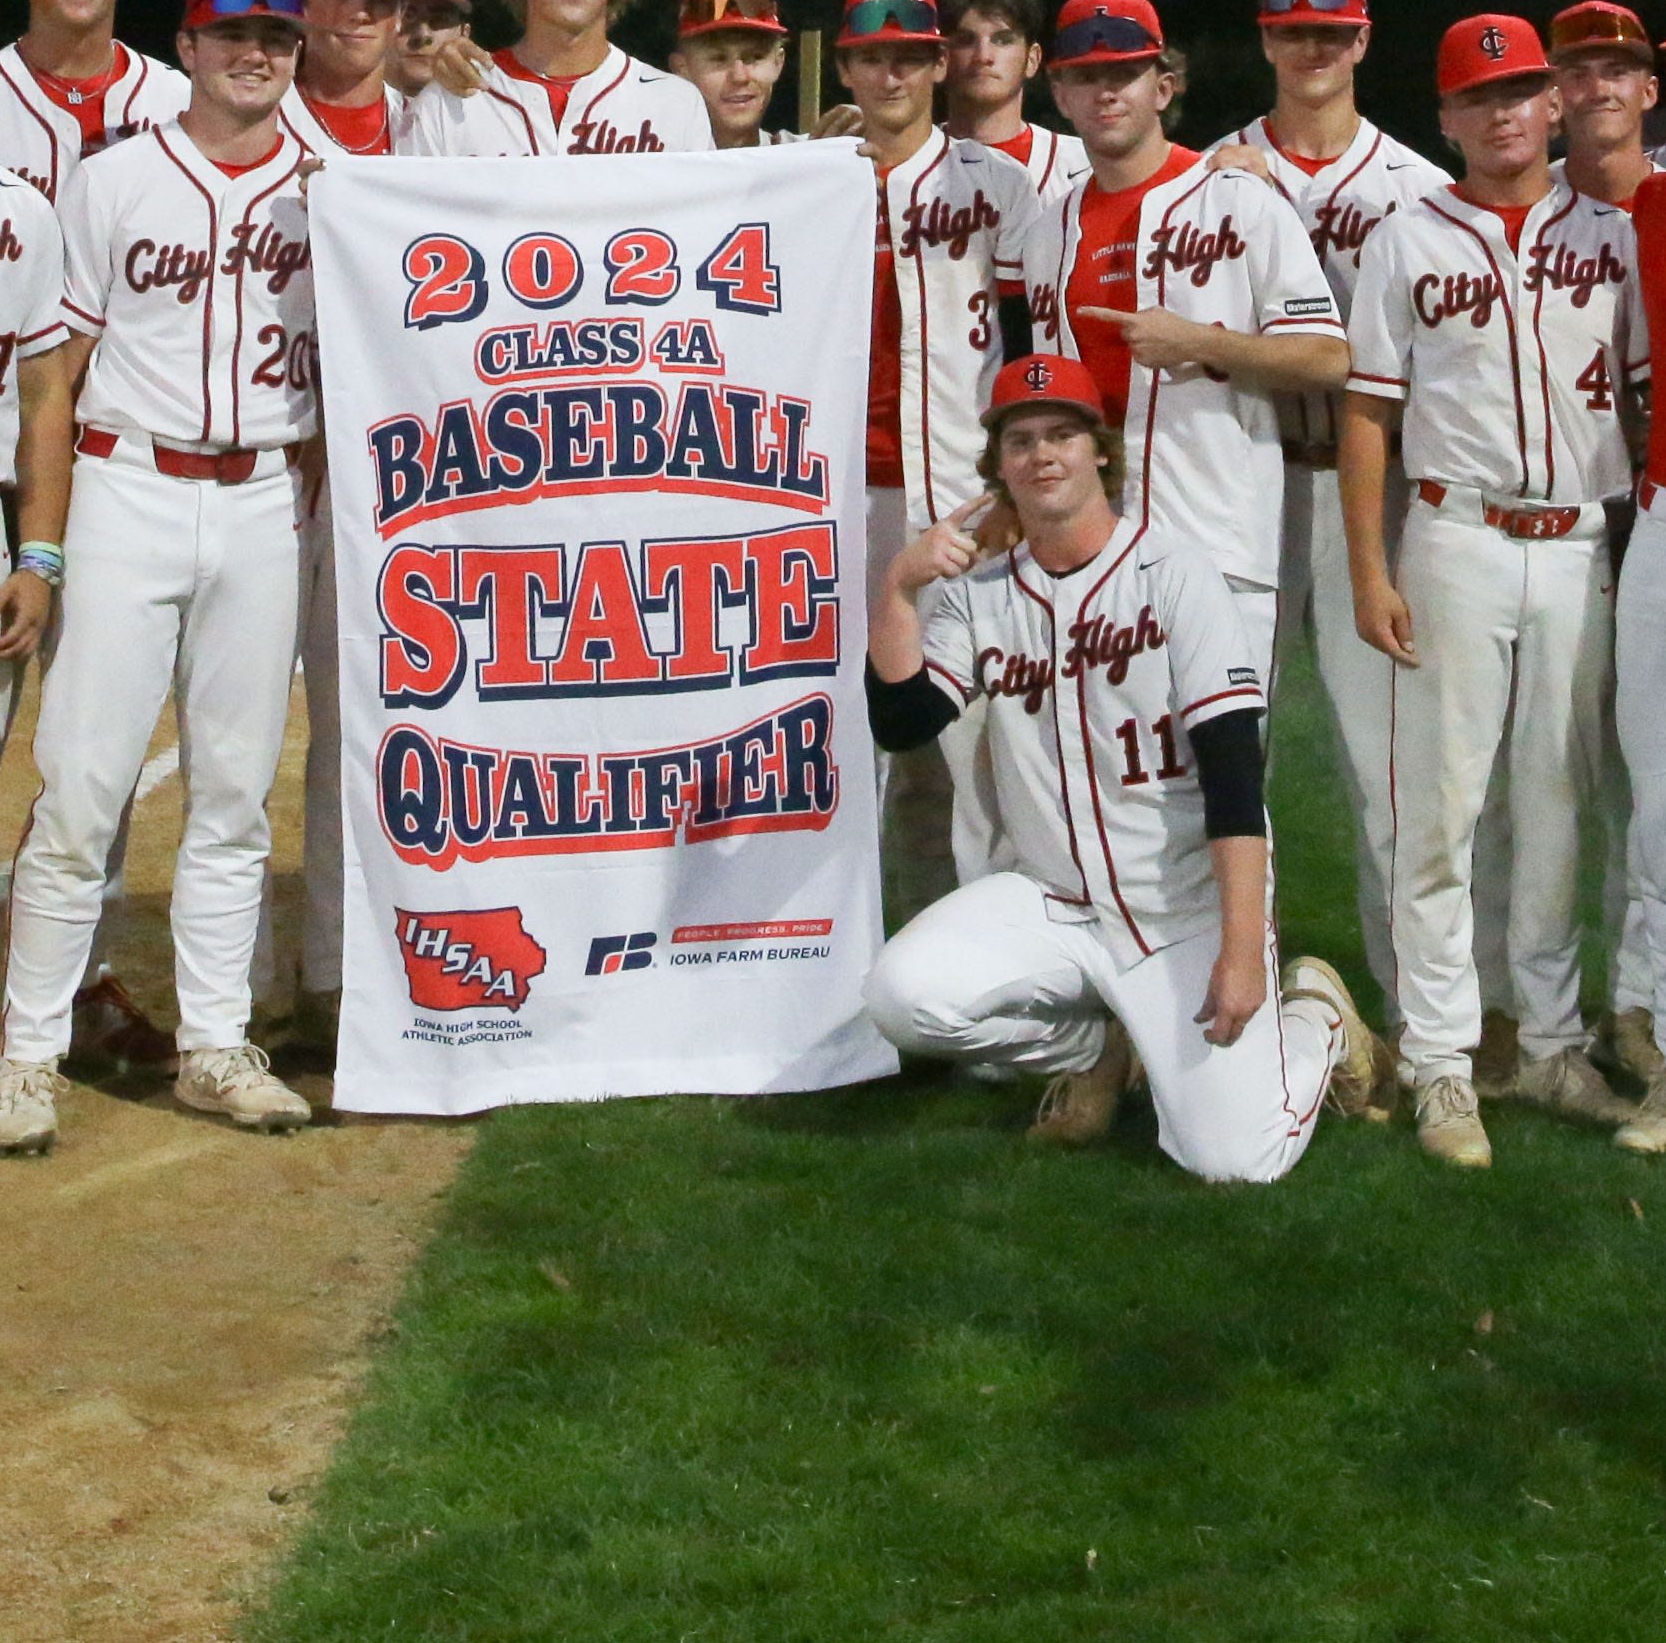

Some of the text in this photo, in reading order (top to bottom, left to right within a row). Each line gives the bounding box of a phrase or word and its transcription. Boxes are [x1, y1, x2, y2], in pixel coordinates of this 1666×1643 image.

[899, 188, 1000, 261] High
[1142, 214, 1246, 287] High
[125, 238, 212, 304] City
[402, 222, 782, 331] 2024
[1414, 242, 1627, 329] City High
[476, 318, 726, 384] CLASS 4A
[968, 290, 992, 351] 3
[1575, 347, 1613, 411] 4
[368, 382, 830, 536] BASEBALL
[376, 520, 840, 710] STATE
[973, 604, 1170, 715] City High
[376, 693, 839, 868] QUALIFIER
[1116, 713, 1187, 787] 11
[405, 917, 516, 998] IHSAA
[670, 945, 831, 966] IOWA FARM BUREAU
[401, 1028, 534, 1046] ATHLETIC ASSOCIATION
[414, 1017, 522, 1034] IOWA HIGH SCHOOL
